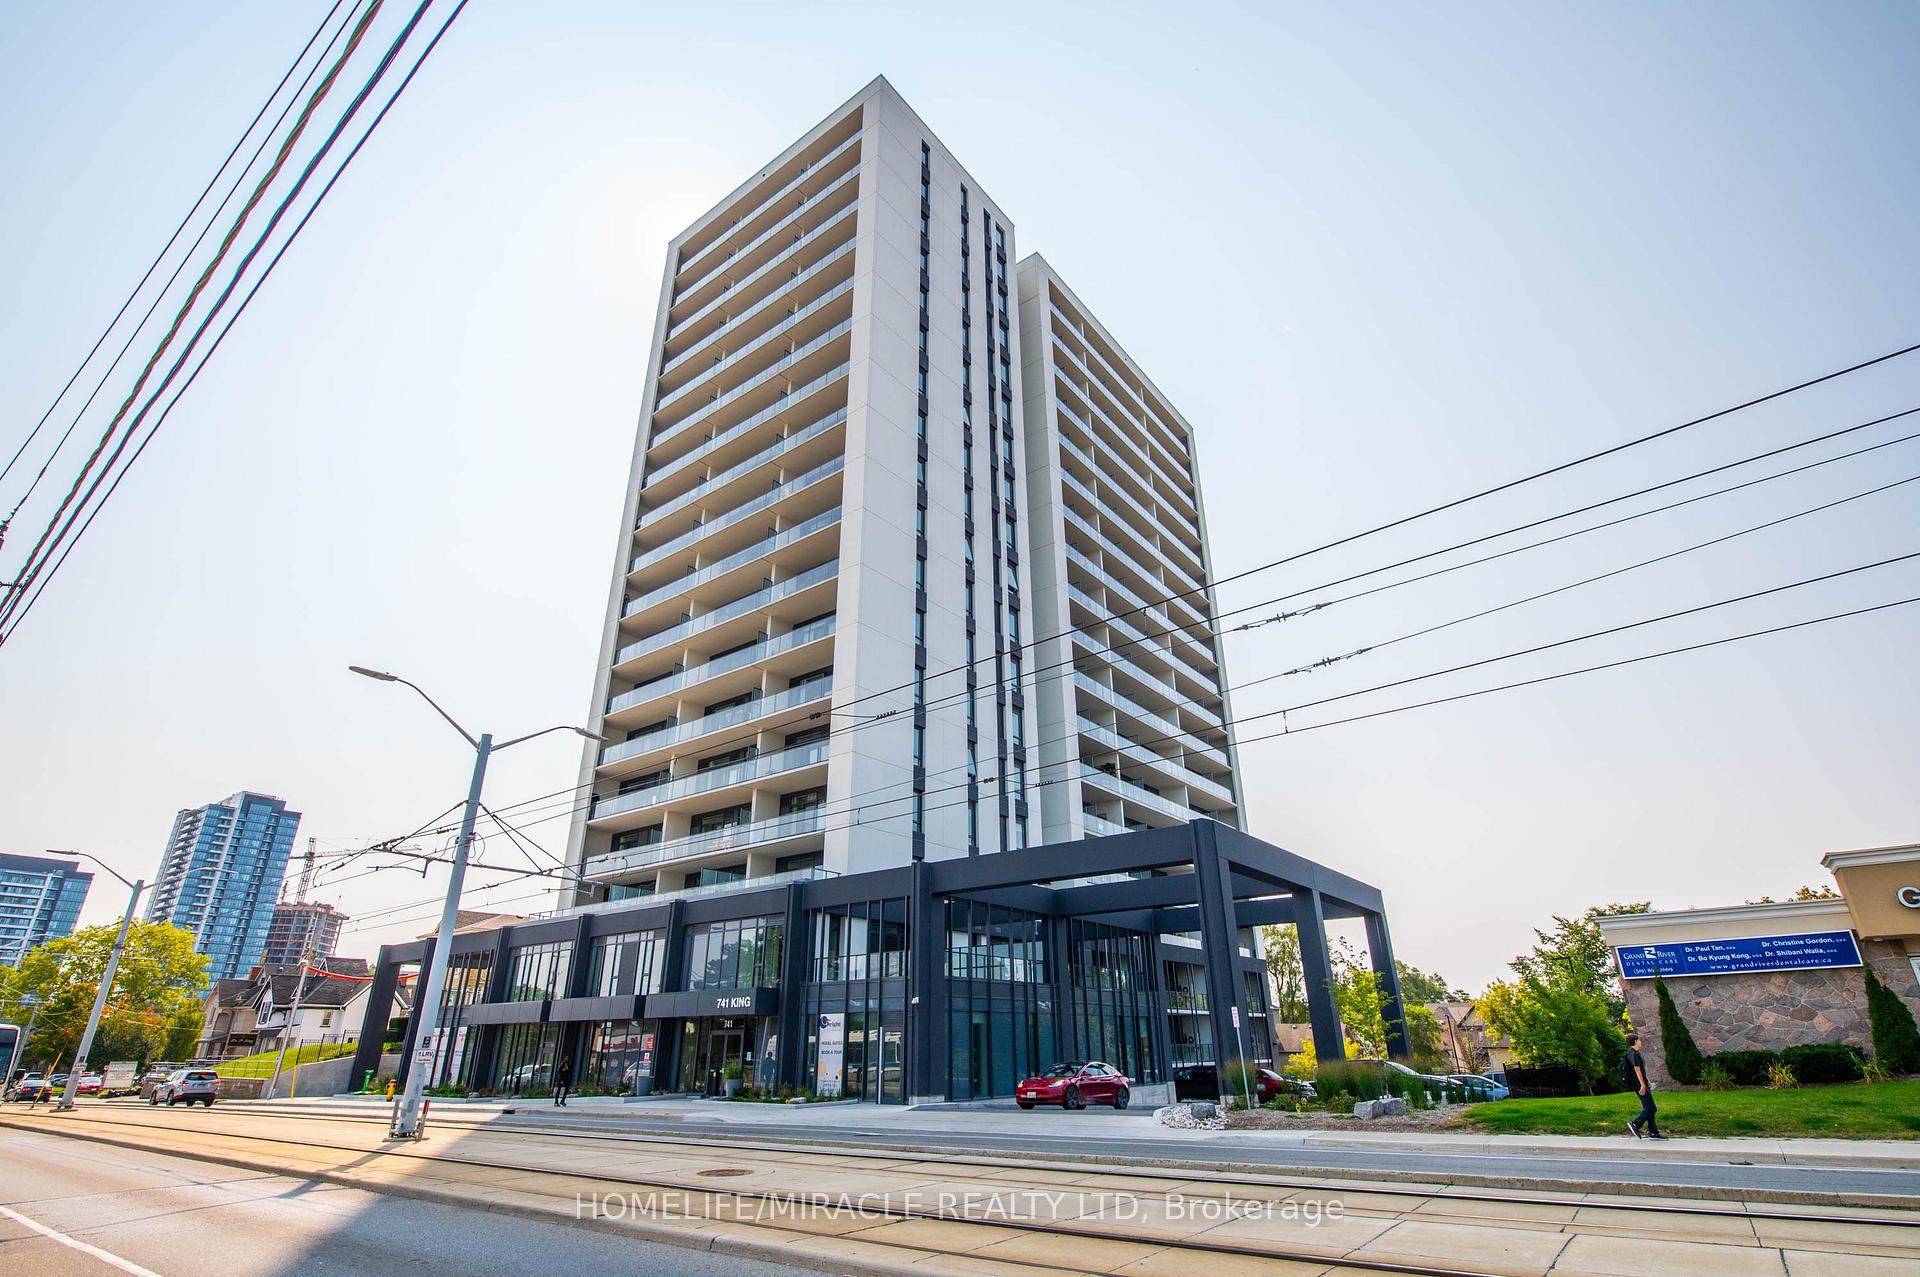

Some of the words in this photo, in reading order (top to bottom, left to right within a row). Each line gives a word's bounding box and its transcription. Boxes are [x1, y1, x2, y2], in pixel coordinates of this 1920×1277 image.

[1772, 939, 1805, 947] Christine
[1805, 937, 1835, 945] Gordon,
[1623, 952, 1645, 960] GRAND
[1656, 950, 1677, 958] RIVER
[1776, 949, 1803, 957] Shibani
[1708, 954, 1731, 962] Kyung
[1625, 959, 1656, 967] DENTAL
[1709, 957, 1832, 970] www.grandriverdentalcare.ca
[716, 997, 729, 1009] 741
[730, 996, 751, 1008] KING
[723, 1019, 733, 1028] 741
